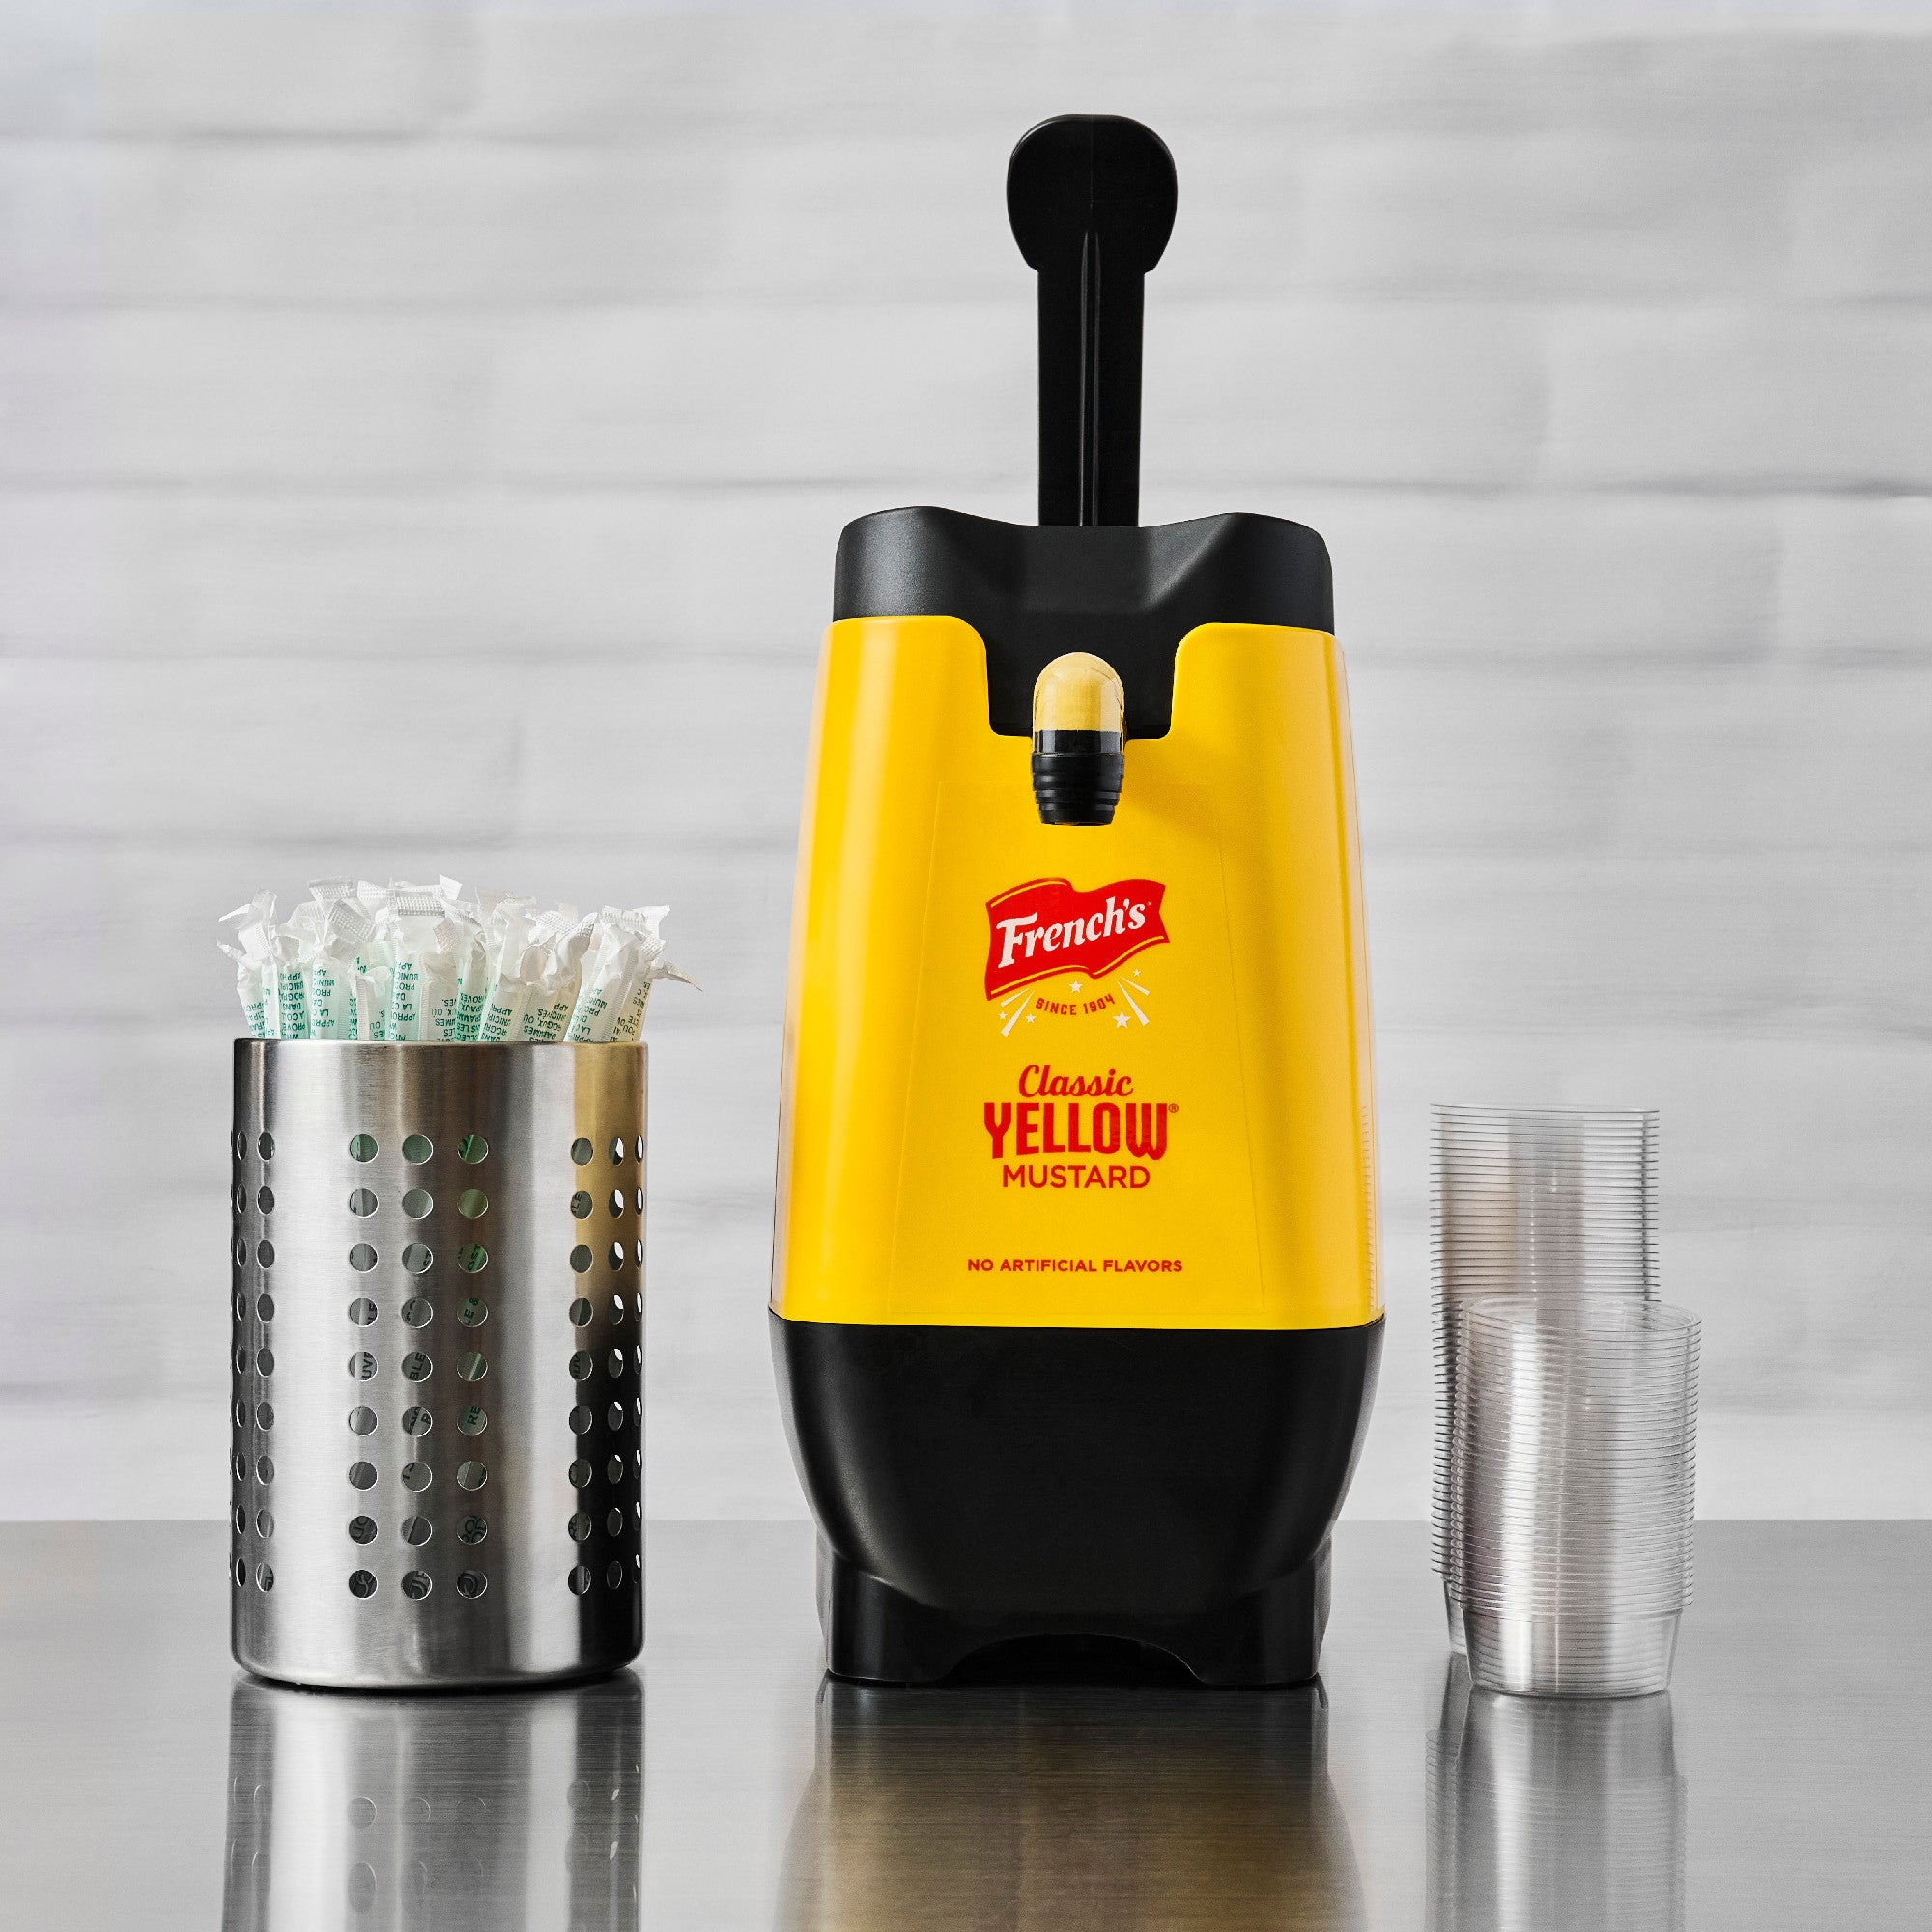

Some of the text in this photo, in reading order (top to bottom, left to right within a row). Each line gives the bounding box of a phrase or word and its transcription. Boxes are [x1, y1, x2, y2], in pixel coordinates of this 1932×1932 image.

[996, 896, 1146, 969] French's
[1035, 993, 1116, 1015] SINCE 1904
[1018, 1064, 1134, 1098] Classic
[1002, 1164, 1151, 1190] MUSTARD
[966, 1257, 1183, 1273] NO ARTIFICIAL FLAVORS
